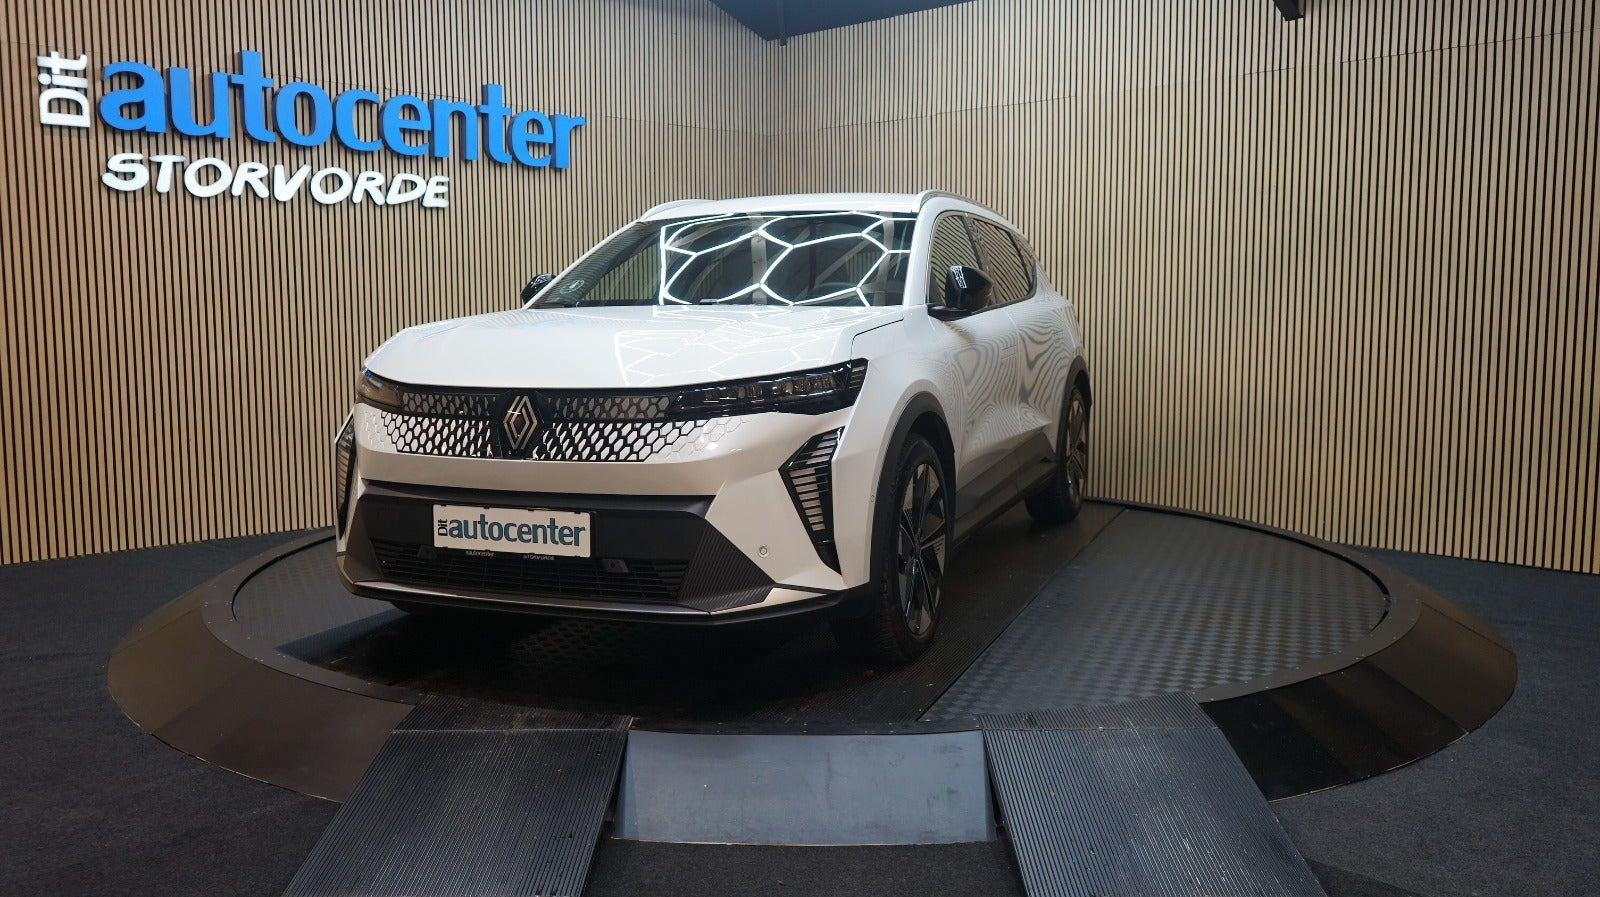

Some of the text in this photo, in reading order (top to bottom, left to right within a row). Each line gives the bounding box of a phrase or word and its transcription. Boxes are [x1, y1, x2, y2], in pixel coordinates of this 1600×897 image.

[37, 50, 586, 169] Dit autocenter
[101, 152, 450, 208] STORVORDE
[437, 514, 586, 546] Dit autocenter
